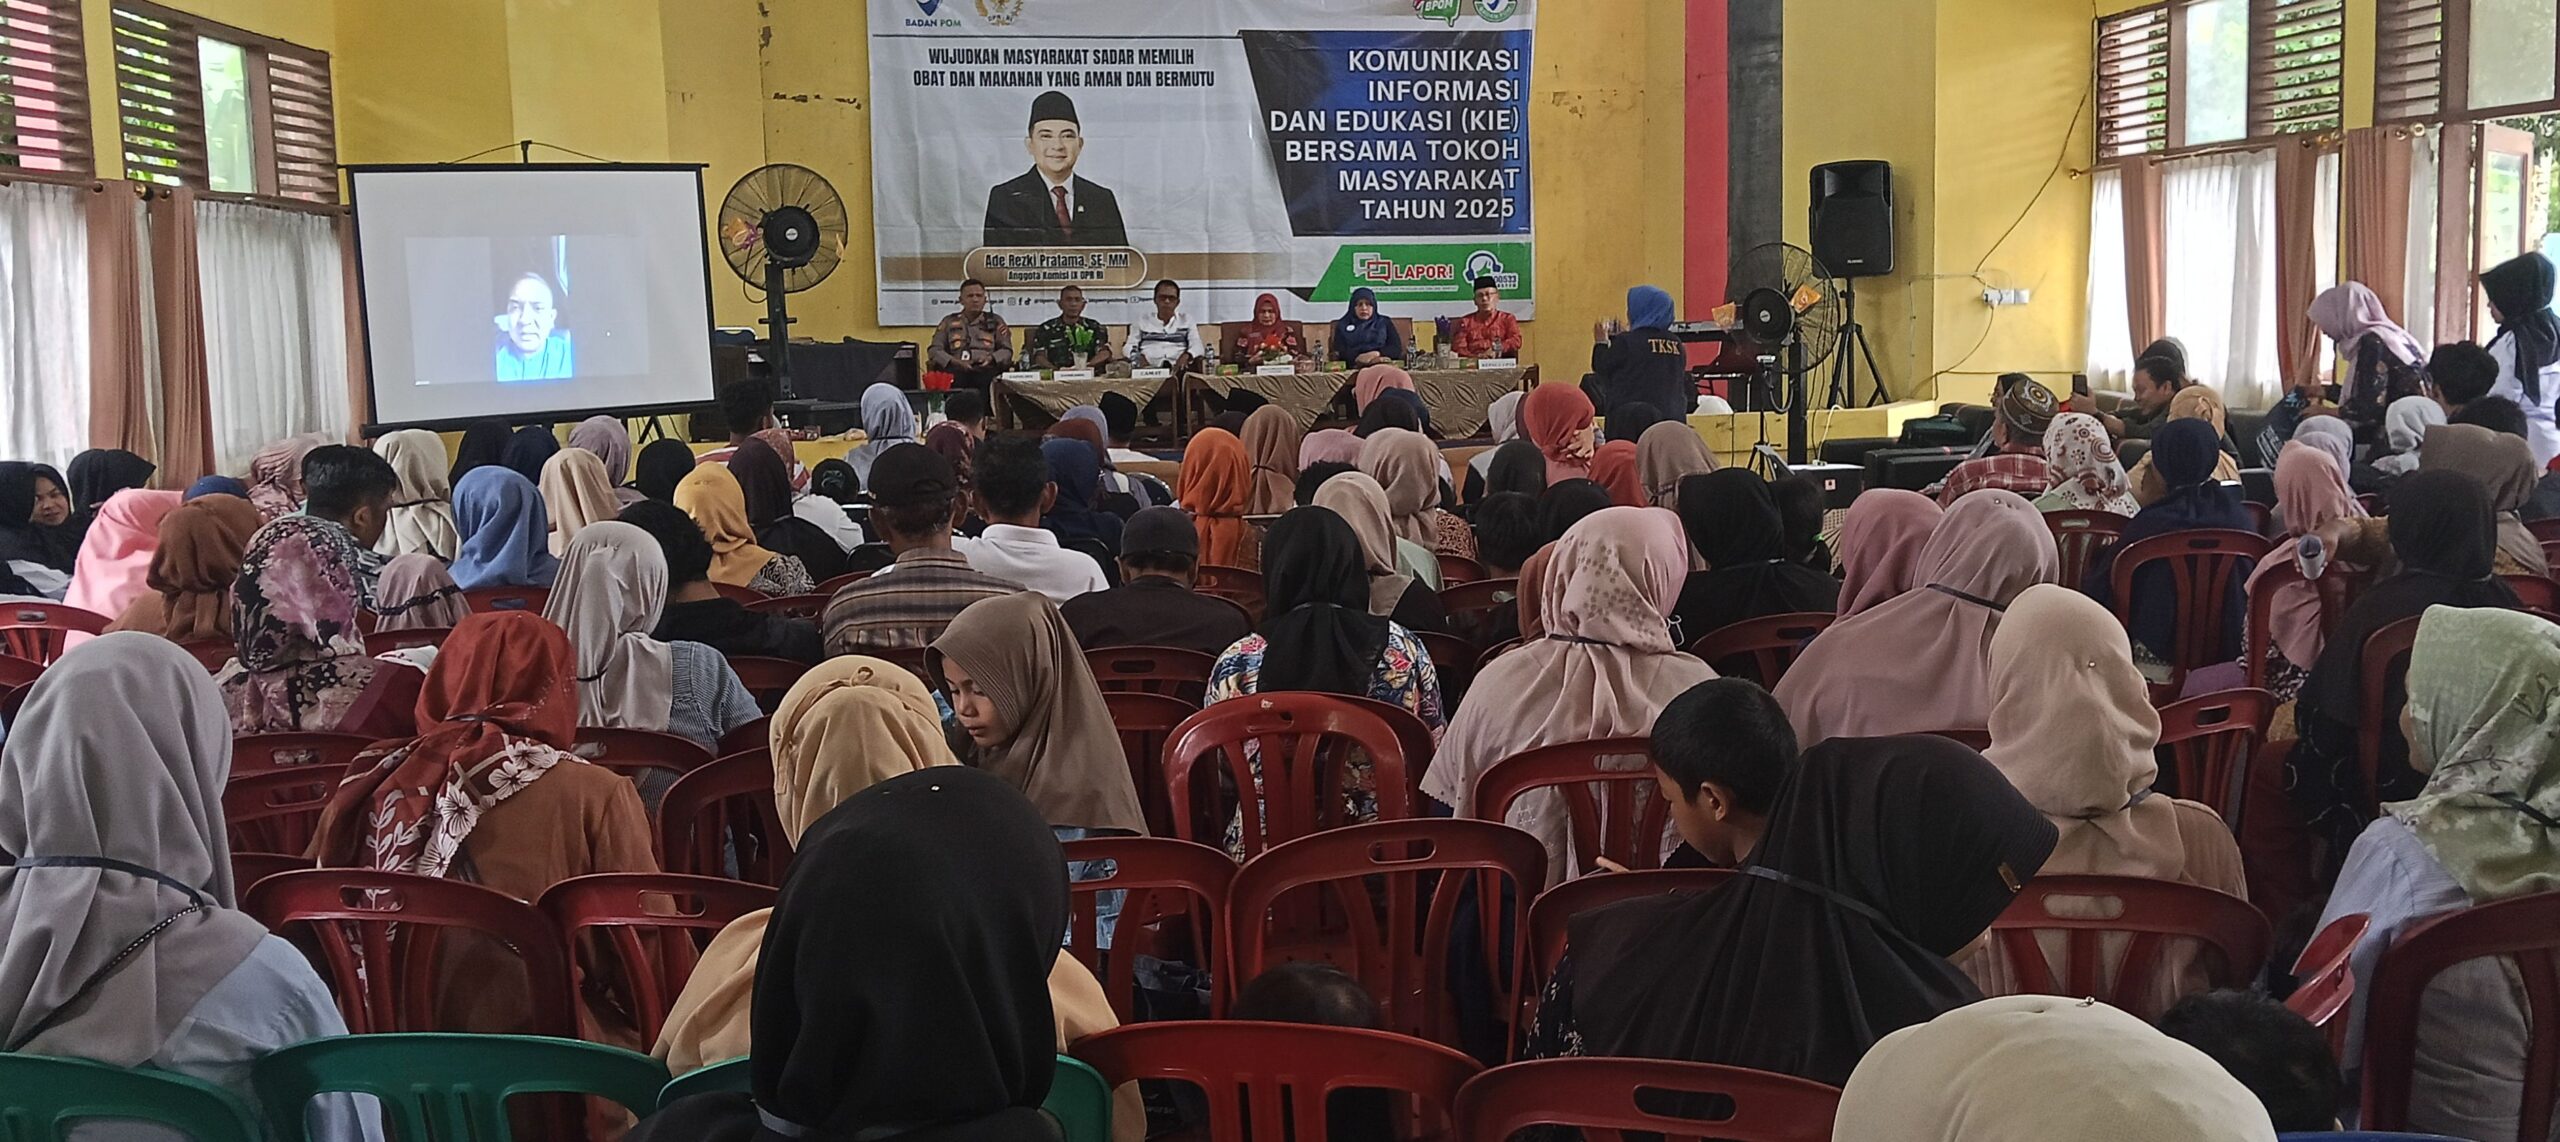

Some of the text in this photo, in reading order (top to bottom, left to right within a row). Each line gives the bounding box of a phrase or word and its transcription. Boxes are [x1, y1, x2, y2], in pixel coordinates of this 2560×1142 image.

[905, 19, 961, 27] BADAN POM
[928, 48, 1194, 65] WUJUDKAN MASYARAKAT SADAR MEMILIH
[1349, 49, 1519, 71] KOMUNIKASI
[913, 70, 1215, 87] OBAT DAN MAKANAN YANG AMAN DAN BERMUTU
[1368, 80, 1519, 102] INFORMASI
[1270, 107, 1520, 134] DAN EDUKASI (KIE)
[1285, 139, 1519, 162] BERSAMA TOKOH
[1338, 168, 1520, 191] MASYARAKAT
[1360, 198, 1515, 219] TAHUN 2025
[985, 254, 1005, 267] Ade
[1008, 253, 1036, 267] Rezki
[1108, 254, 1128, 266] MM
[1008, 271, 1040, 281] Anggota
[1042, 271, 1069, 280] Komisi
[1394, 265, 1453, 279] LAPOR!
[1647, 338, 1680, 355] TKSK
